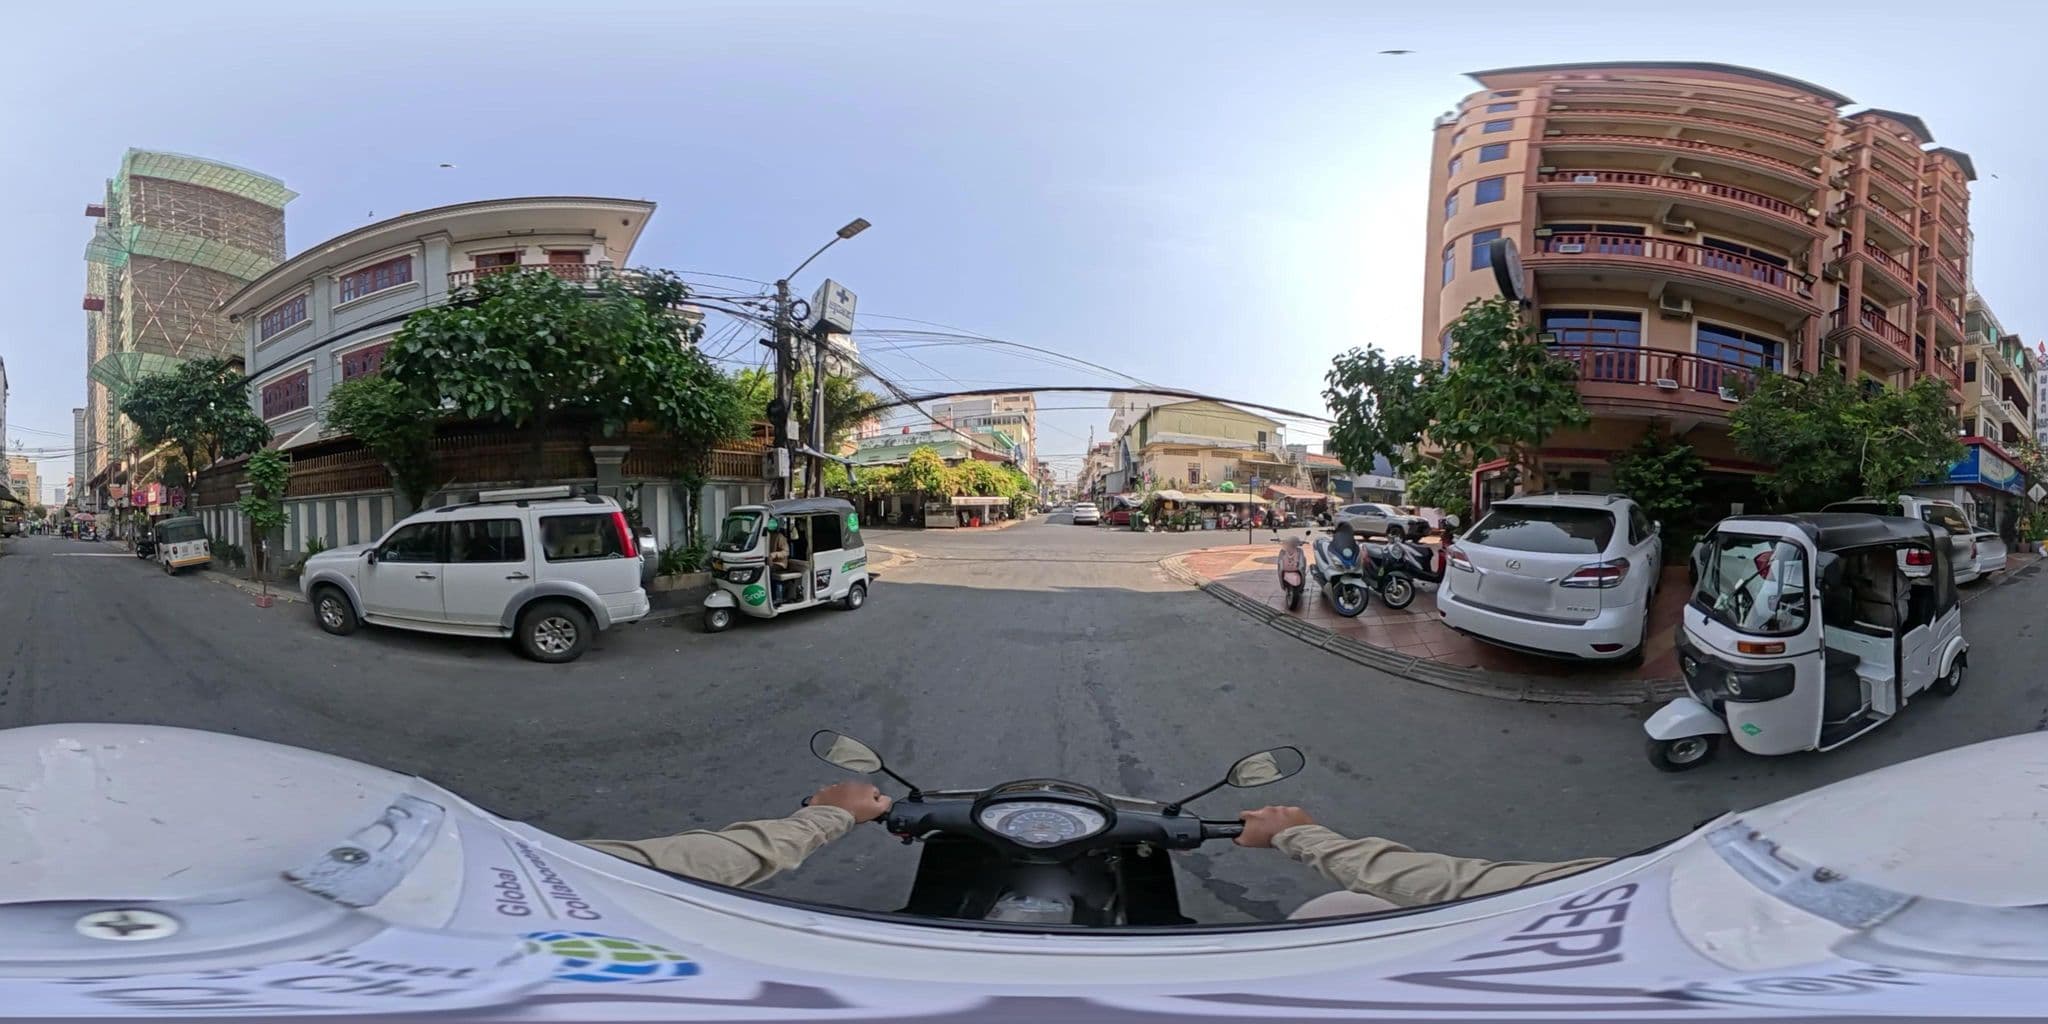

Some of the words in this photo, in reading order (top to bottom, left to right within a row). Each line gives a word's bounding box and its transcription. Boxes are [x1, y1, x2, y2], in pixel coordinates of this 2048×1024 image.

[744, 589, 766, 601] Grab
[493, 868, 531, 916] Global
[517, 842, 601, 920] Collaborative
